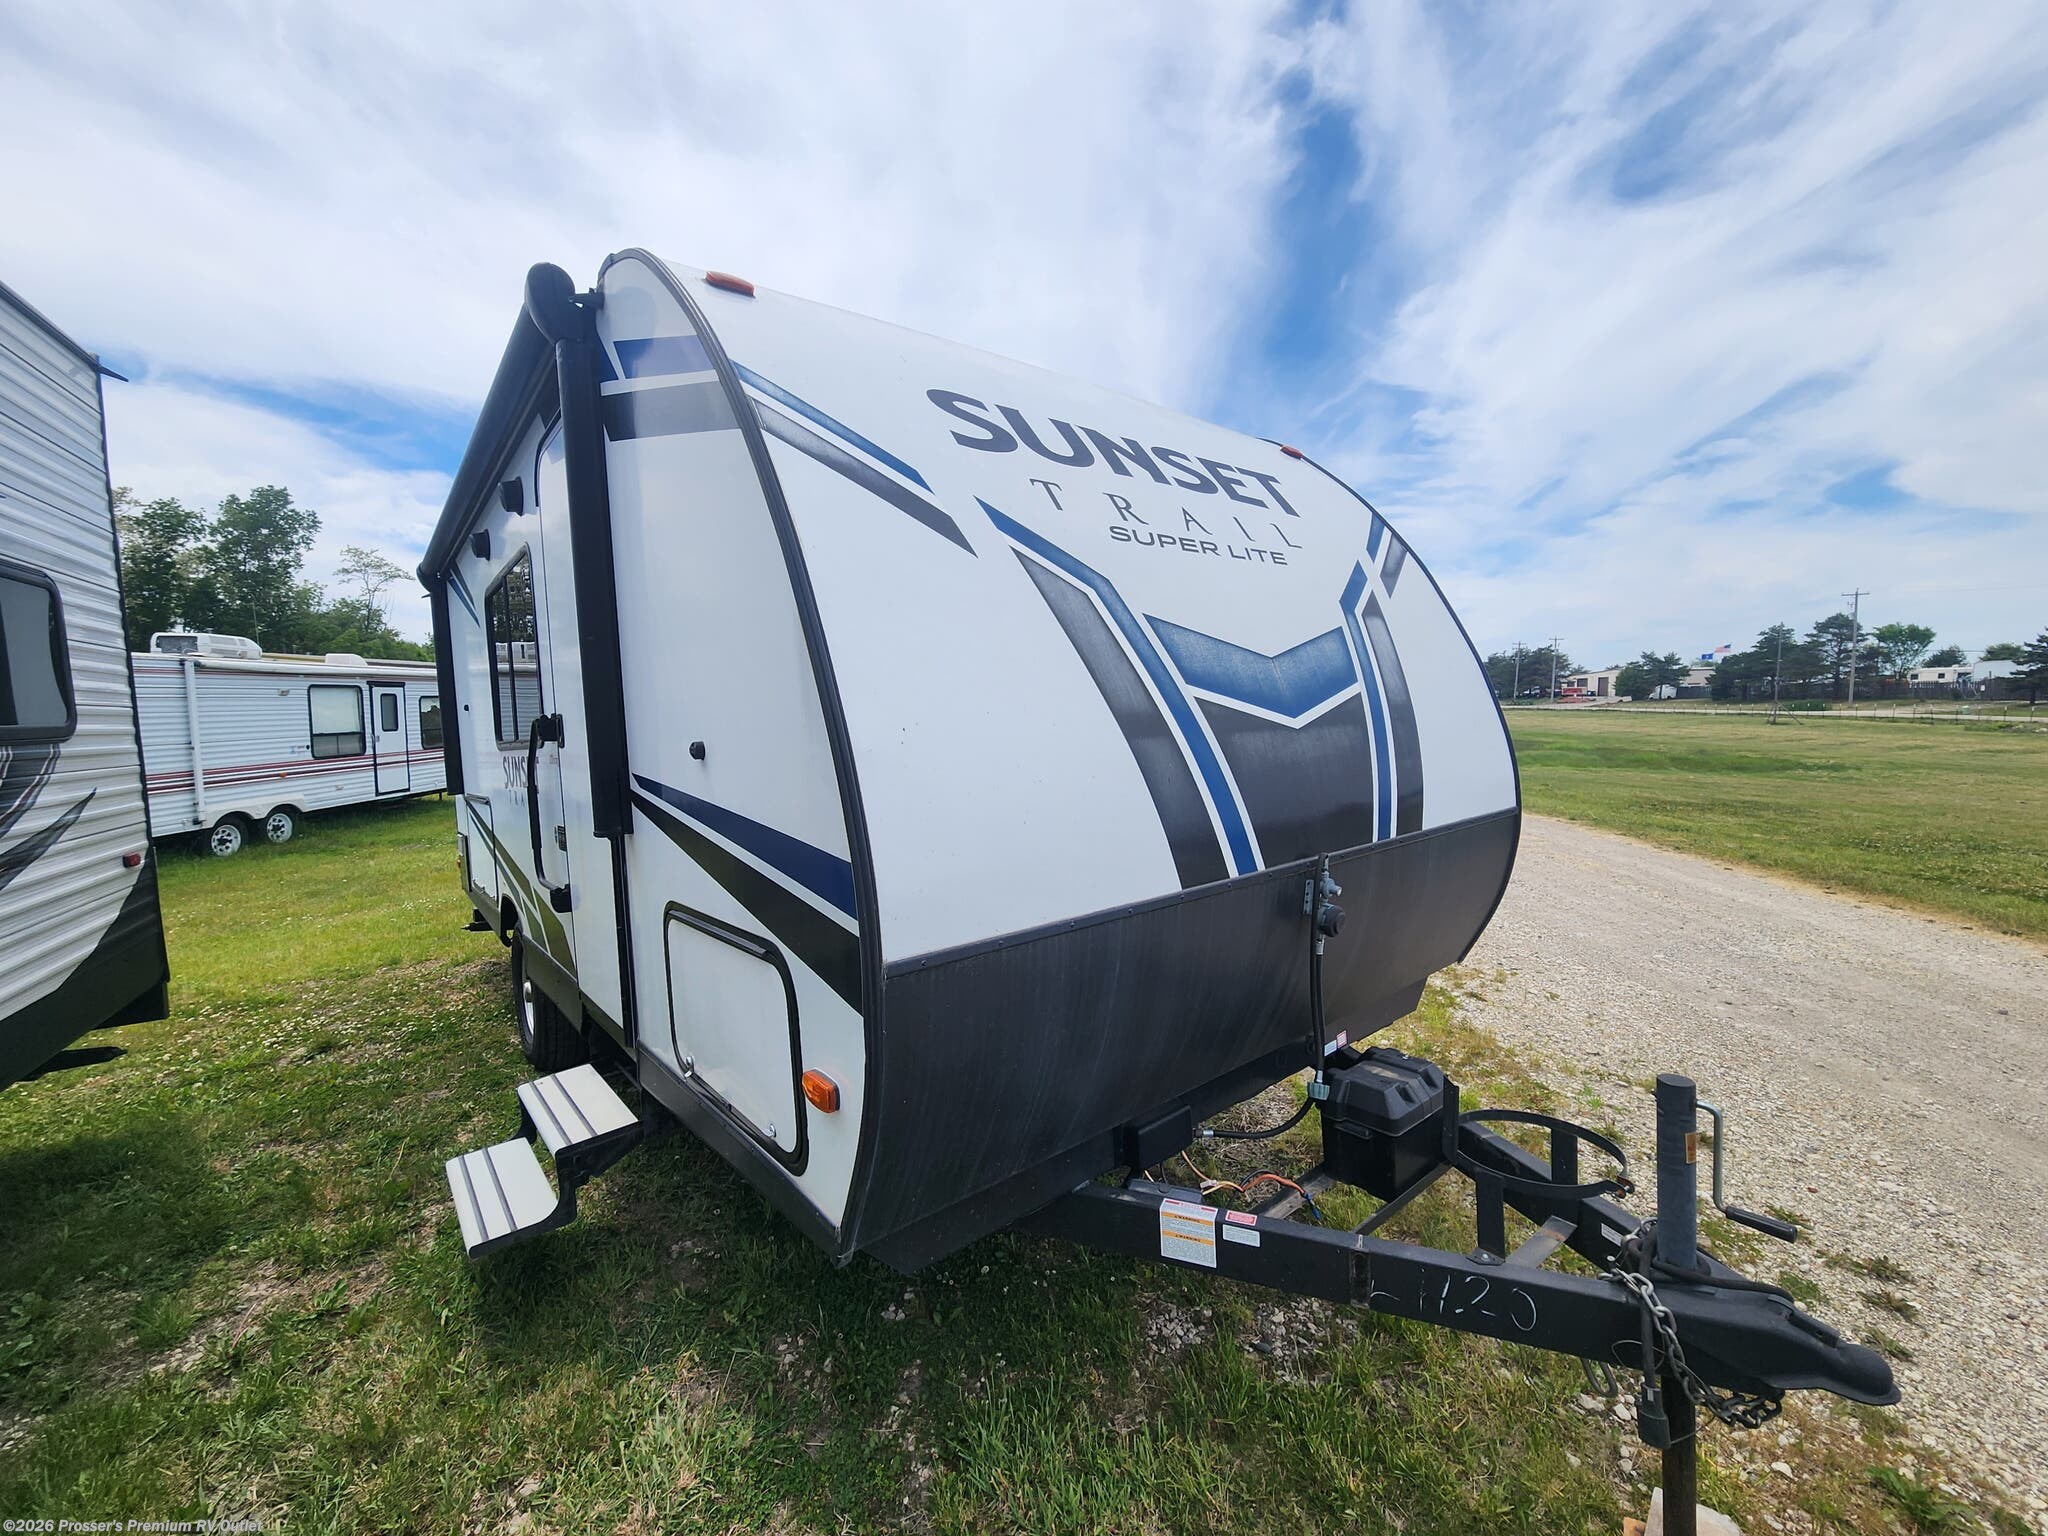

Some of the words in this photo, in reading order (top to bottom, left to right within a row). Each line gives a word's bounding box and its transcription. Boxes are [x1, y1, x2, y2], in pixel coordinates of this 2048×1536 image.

[926, 389, 1301, 519] SUNSET
[1028, 478, 1303, 549] TRAIL
[1109, 525, 1222, 557] SUPER
[1228, 545, 1288, 566] LITE
[503, 756, 539, 789] SUNS
